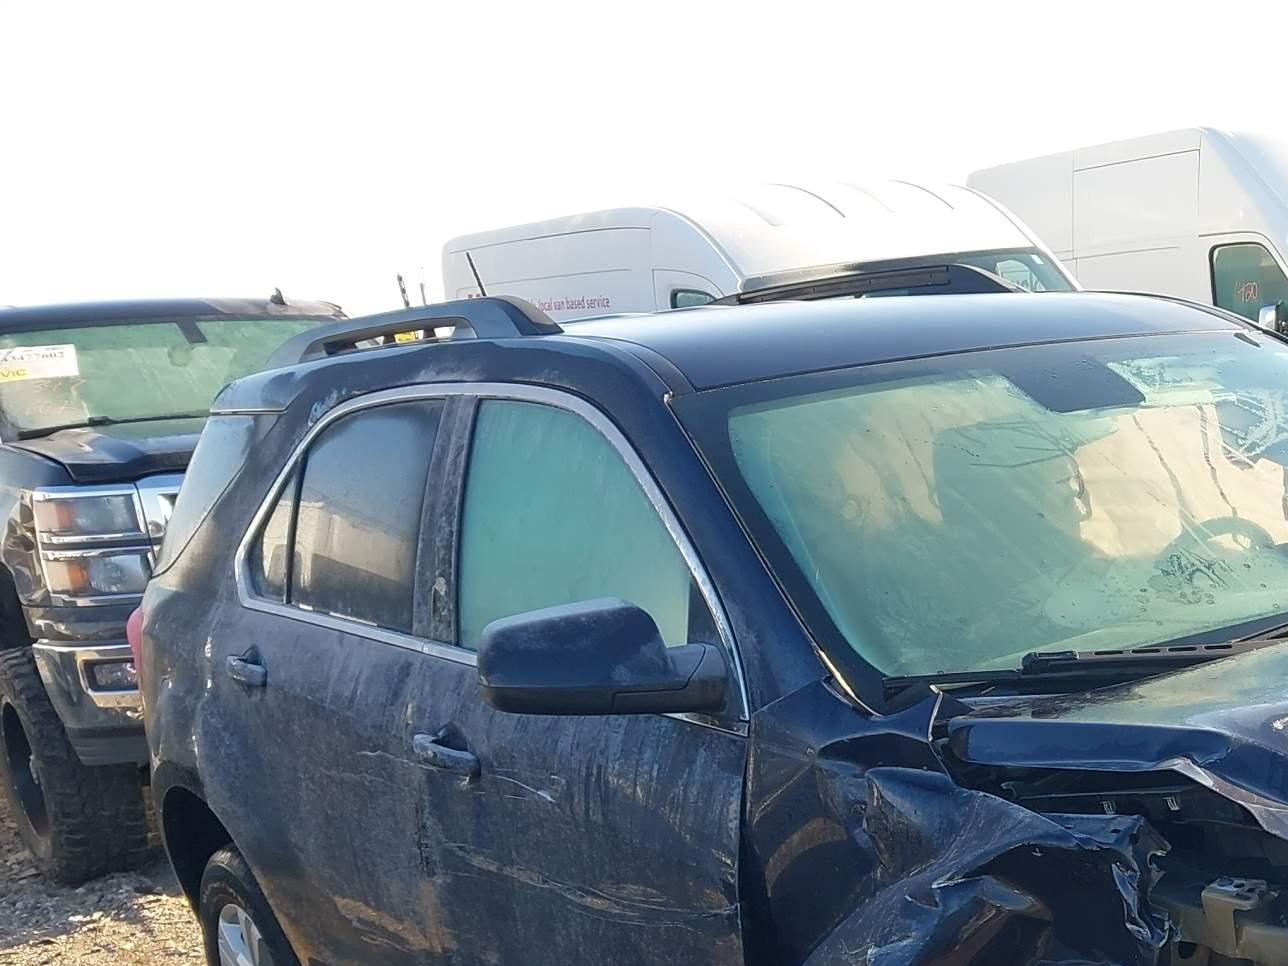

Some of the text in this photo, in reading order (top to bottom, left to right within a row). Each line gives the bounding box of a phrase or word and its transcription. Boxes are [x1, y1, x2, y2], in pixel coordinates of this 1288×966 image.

[553, 300, 565, 311] van
[566, 296, 586, 310] based
[586, 294, 611, 309] service
[0, 368, 28, 378] VIC
